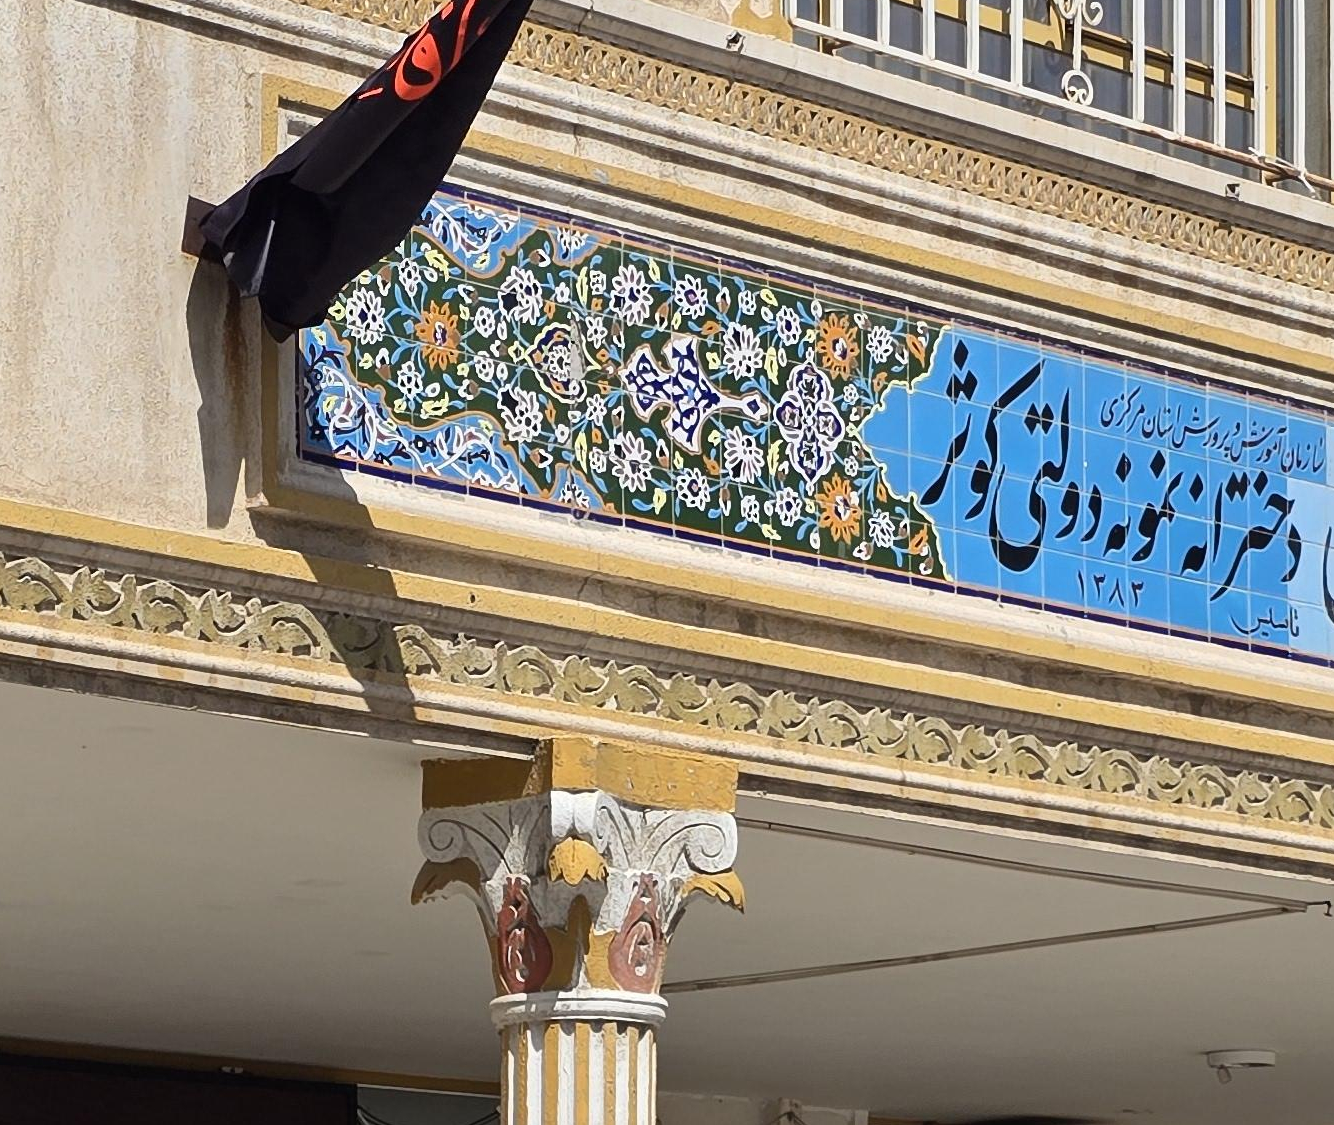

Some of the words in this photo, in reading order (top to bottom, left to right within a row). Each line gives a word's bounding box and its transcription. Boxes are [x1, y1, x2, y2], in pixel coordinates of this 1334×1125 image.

[920, 338, 1047, 521] کوثر
[1100, 385, 1146, 433] مرکزی
[1141, 404, 1182, 438] استان
[1172, 406, 1231, 459] پرورش
[1230, 420, 1288, 462] آموزش
[1279, 436, 1325, 473] سازمان
[988, 387, 1103, 574] دولتی
[1102, 448, 1184, 563] نمونه
[1180, 469, 1303, 602] دخترانه
[1076, 569, 1145, 609] ۱۳۸۳
